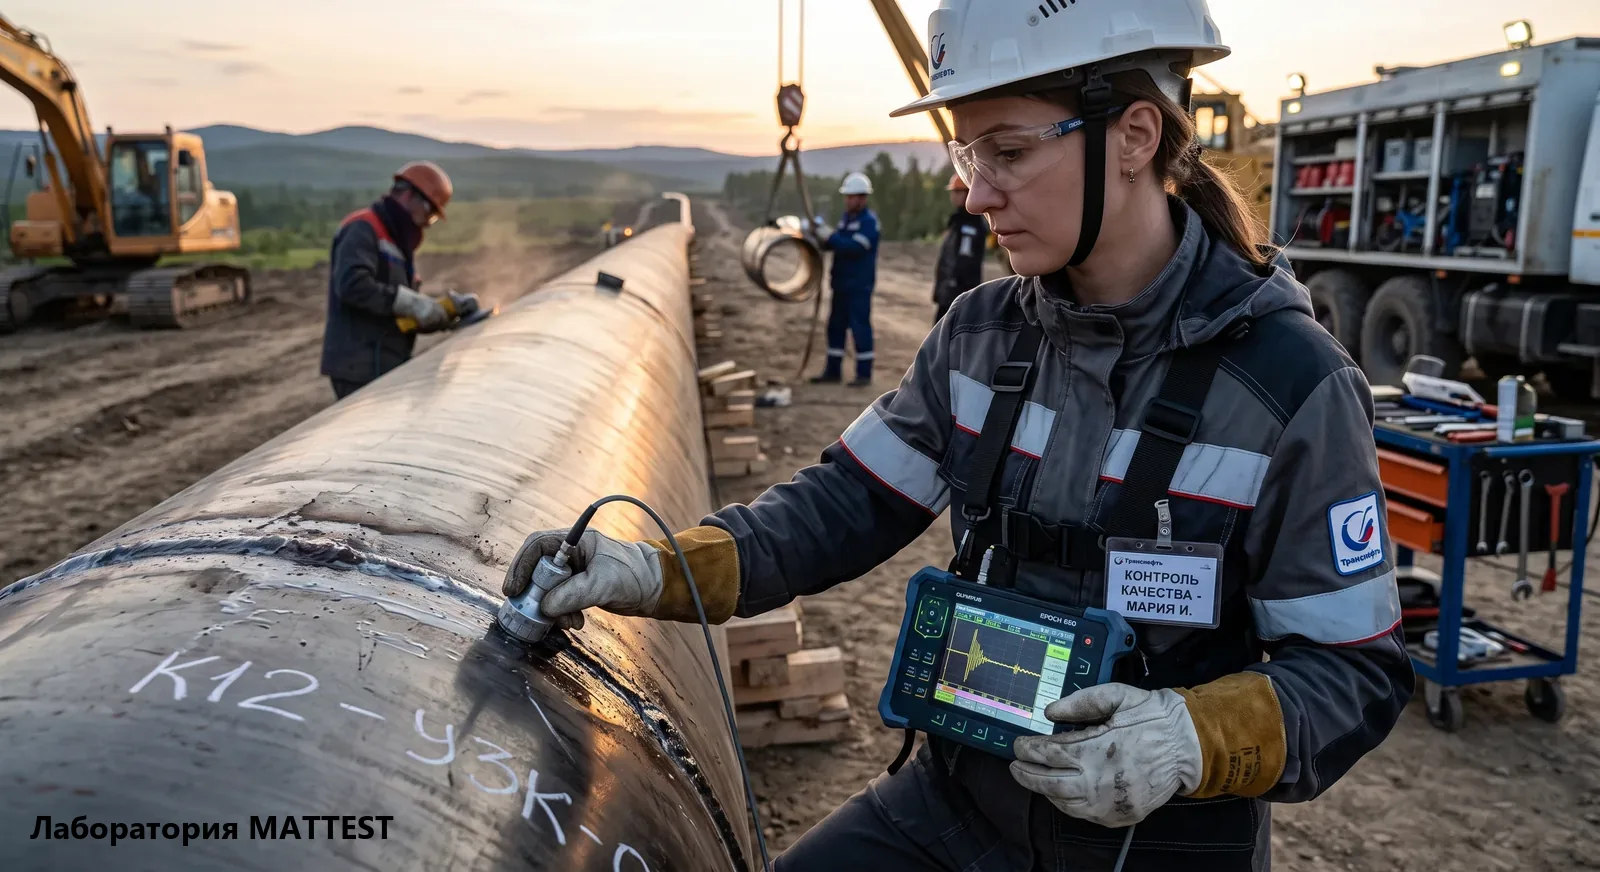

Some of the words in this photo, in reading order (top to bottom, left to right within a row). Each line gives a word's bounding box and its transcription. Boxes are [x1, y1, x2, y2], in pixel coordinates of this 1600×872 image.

[1124, 569, 1200, 586] КОНТРОЛЬ
[955, 591, 983, 603] OLYMPUS
[1121, 584, 1193, 601] КАЧЕСТВА
[1126, 600, 1175, 615] МАРИЯ
[1179, 604, 1193, 616] И.
[1039, 612, 1063, 624] EPOCH
